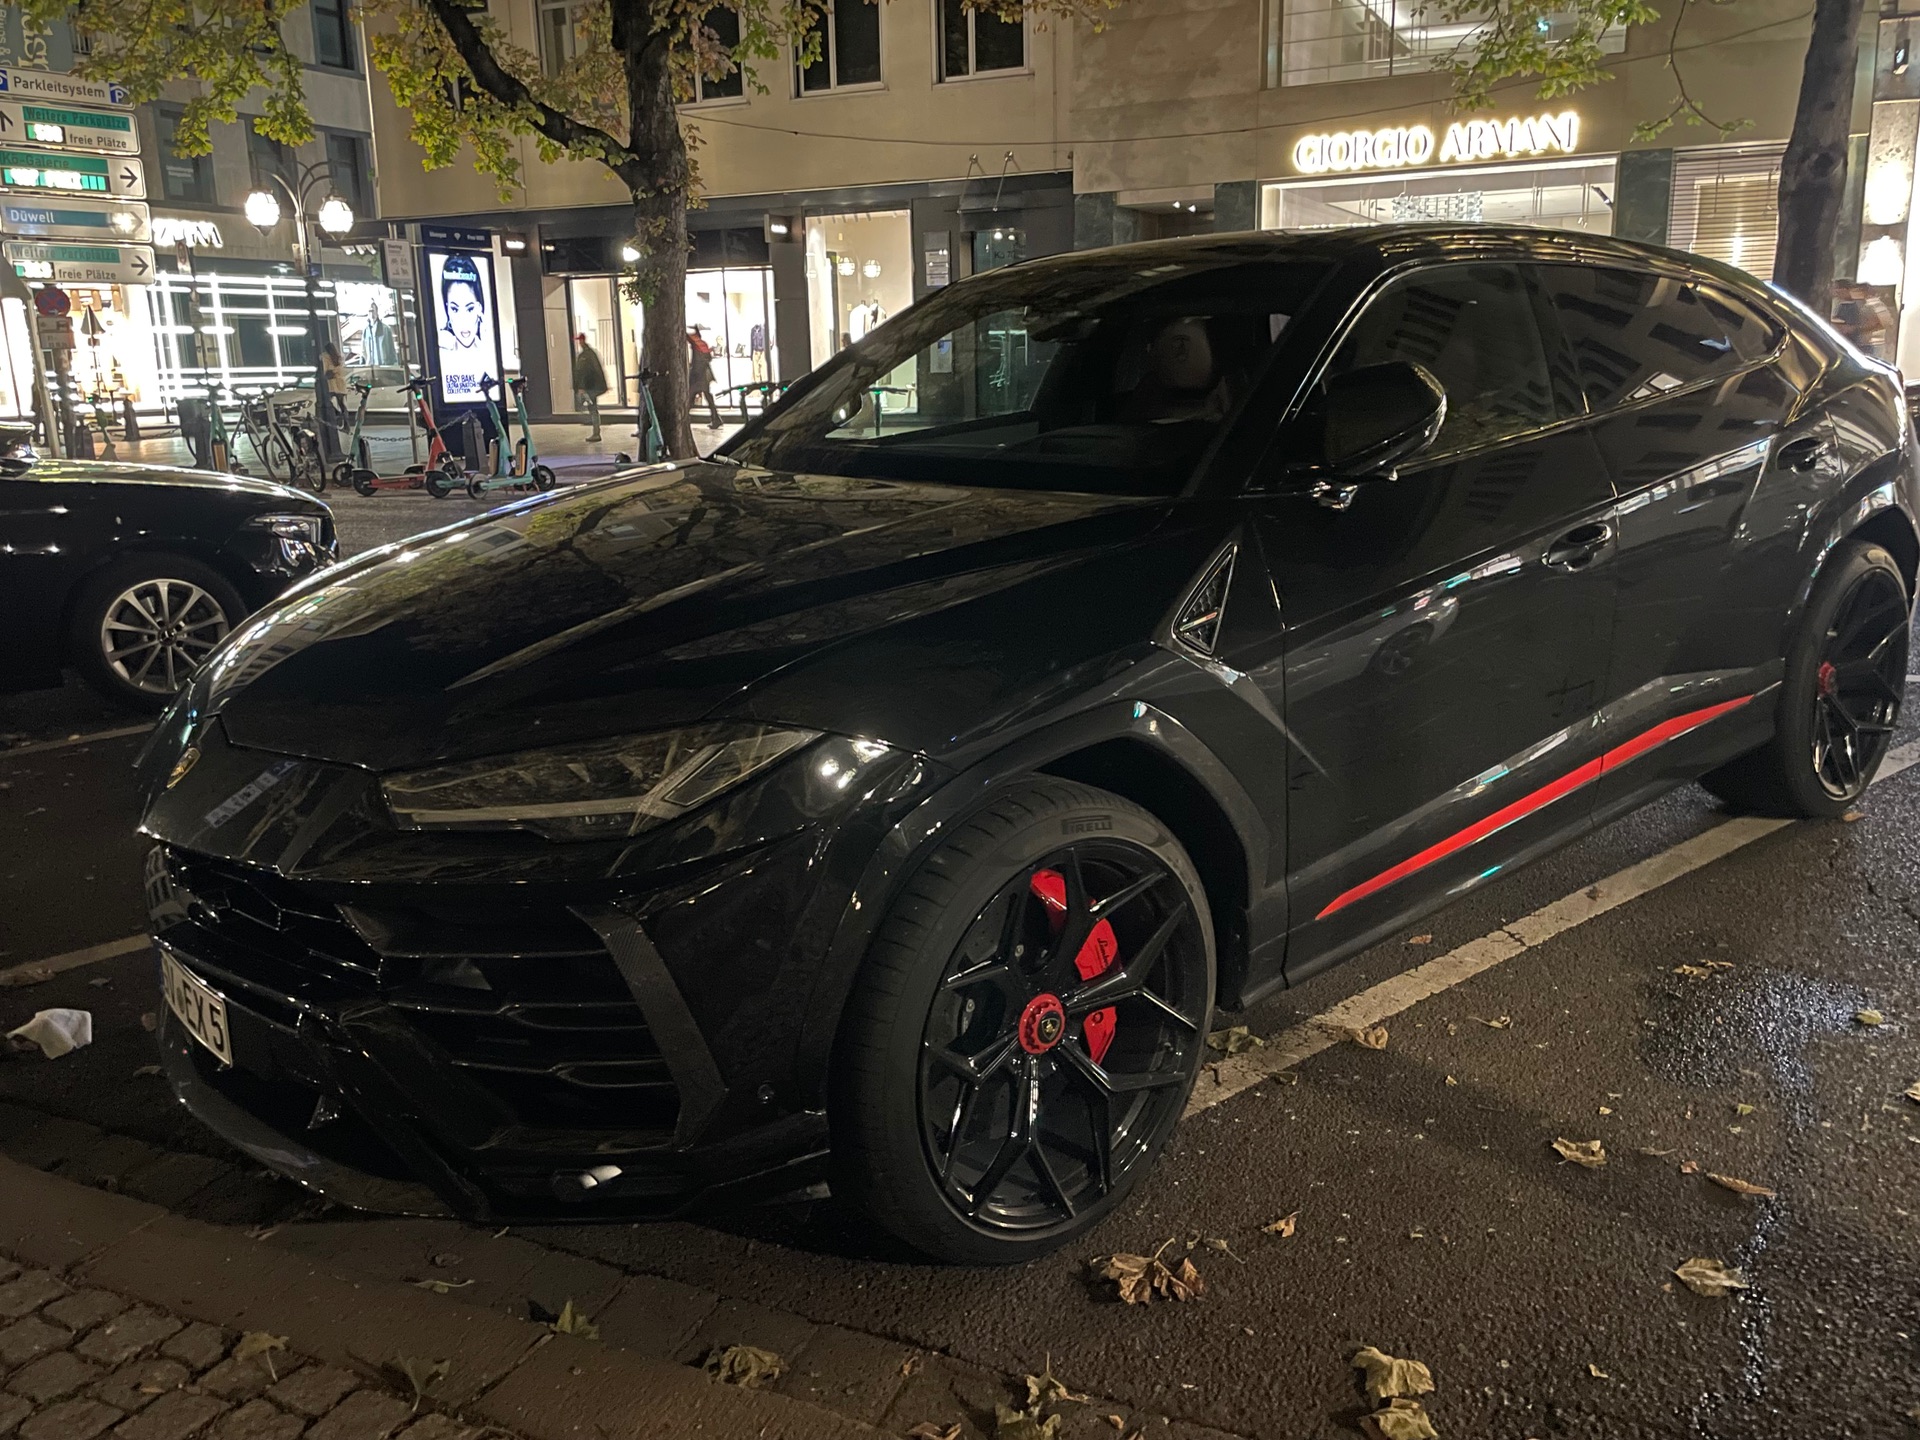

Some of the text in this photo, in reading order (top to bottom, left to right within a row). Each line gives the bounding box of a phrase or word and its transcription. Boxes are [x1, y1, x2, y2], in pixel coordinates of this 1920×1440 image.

[13, 76, 105, 98] Parkleitsystem
[27, 107, 128, 129] Weitere Parkplätze
[69, 133, 93, 145] freie
[97, 136, 127, 149] Plätze
[1294, 112, 1577, 171] GIORGIO ARMANI
[5, 154, 70, 169] Kö-Galerie
[10, 209, 55, 224] Düwell
[11, 244, 117, 261] Weitere Parkplätze
[58, 268, 82, 279] freie
[86, 269, 117, 280] Plätze
[445, 374, 475, 383] EASY BAKE
[1061, 815, 1112, 835] PIRELLI
[181, 978, 209, 1042] EX
[208, 1002, 225, 1053] 5
